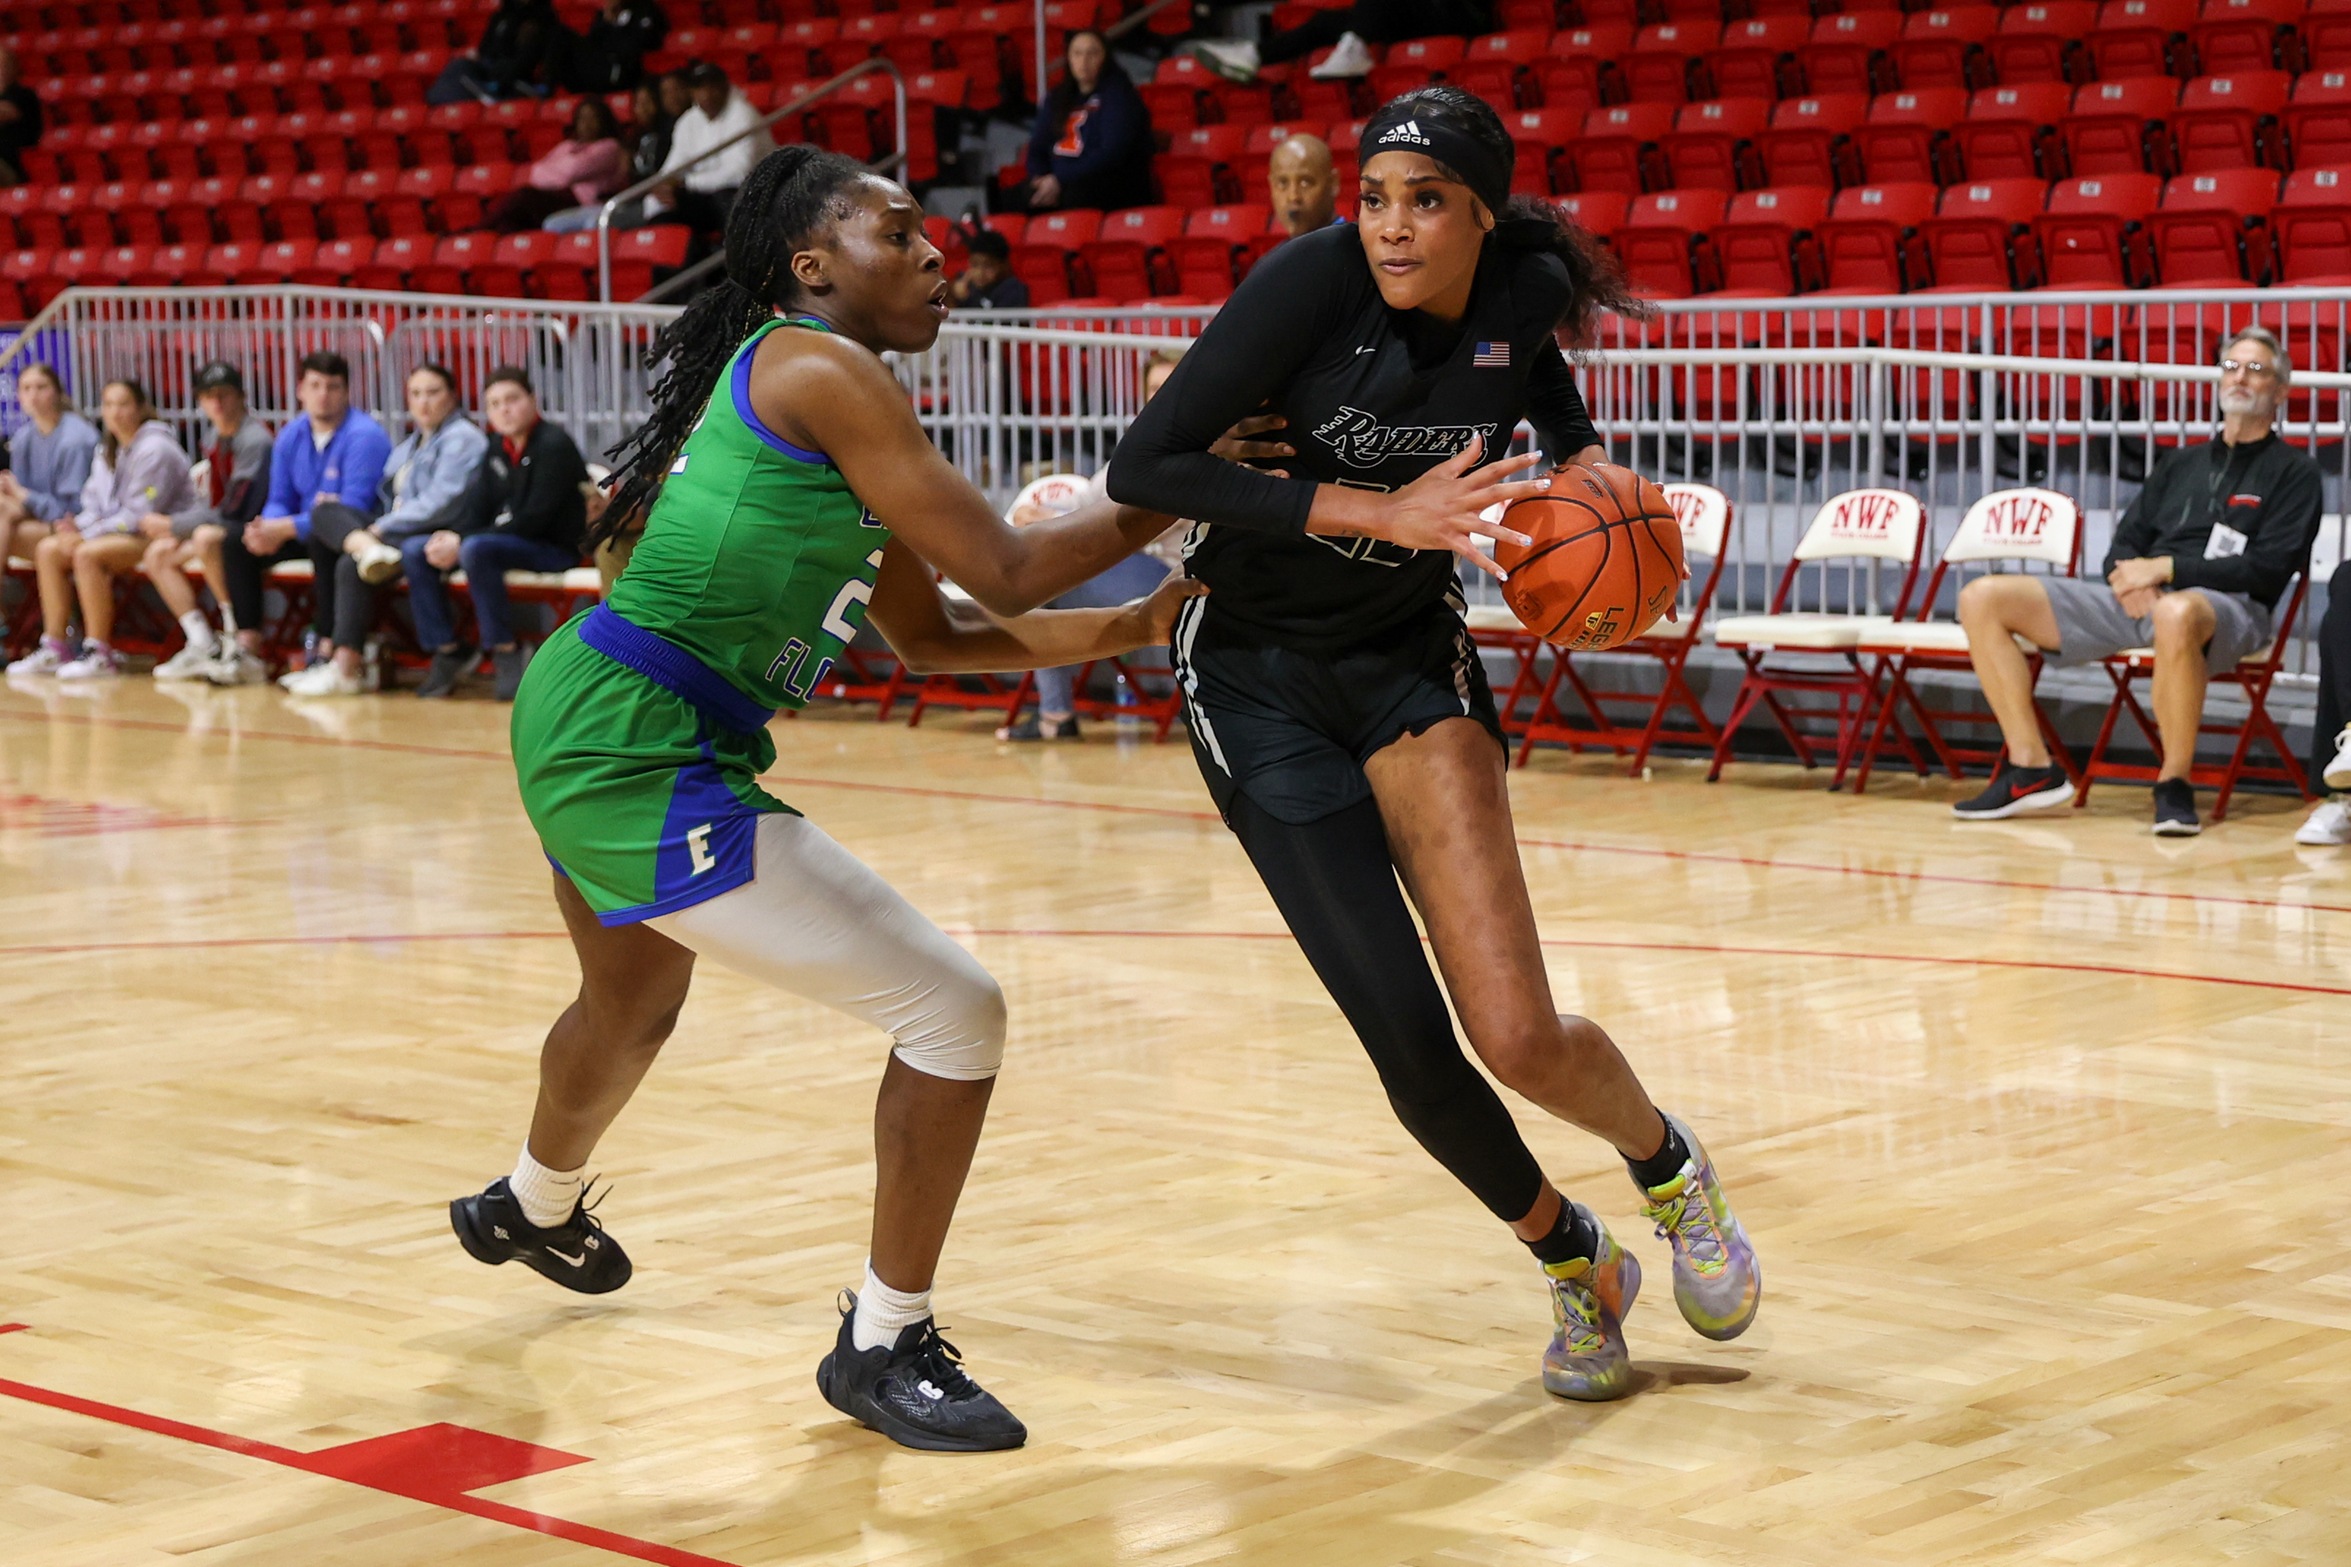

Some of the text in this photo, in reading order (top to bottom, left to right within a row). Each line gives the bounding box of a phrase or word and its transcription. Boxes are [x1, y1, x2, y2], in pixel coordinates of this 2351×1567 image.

[1378, 132, 1431, 146] adidas
[1668, 492, 1706, 527] WF
[1832, 495, 1899, 529] NWF
[1984, 497, 2053, 535] NWF
[687, 823, 716, 878] E
